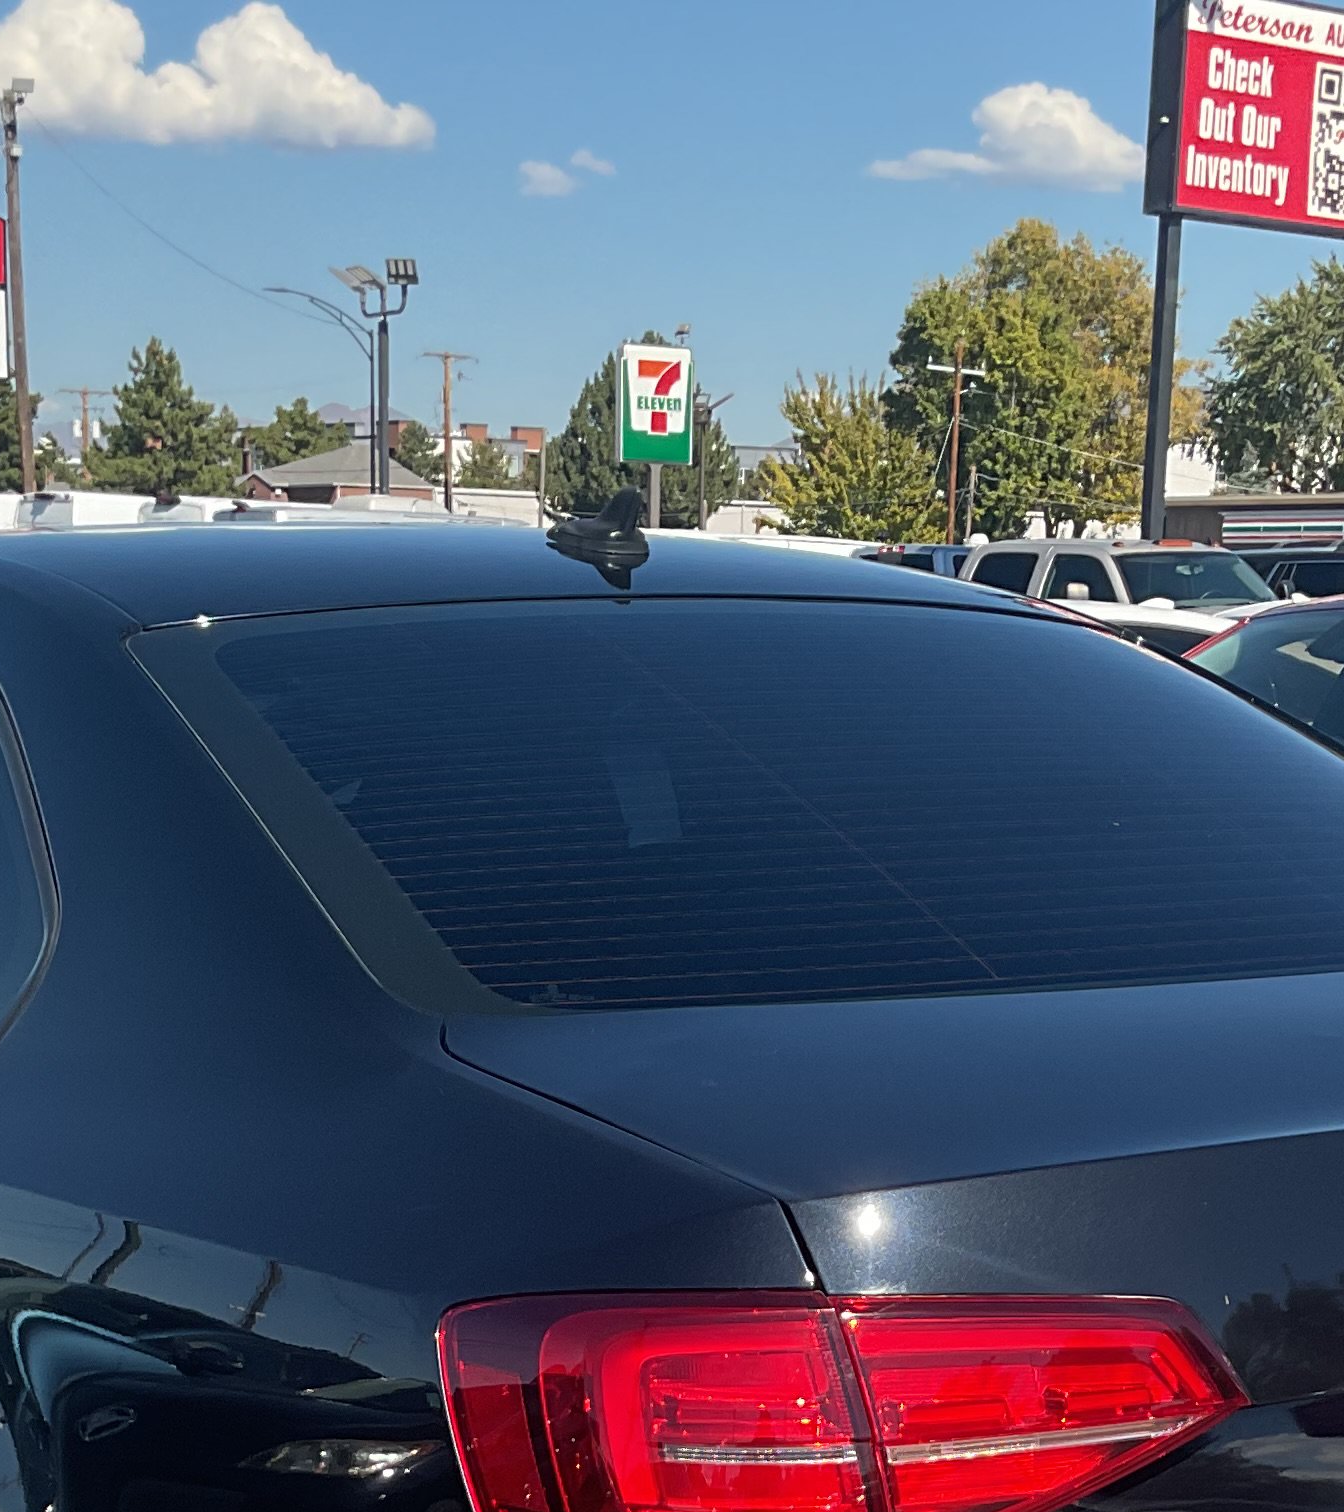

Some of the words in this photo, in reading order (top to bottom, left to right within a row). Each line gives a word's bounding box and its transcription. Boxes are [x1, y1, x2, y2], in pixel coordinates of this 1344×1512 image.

[1198, 0, 1313, 43] Peterson
[1208, 47, 1274, 98] Check
[1199, 97, 1235, 143] Out
[1241, 104, 1281, 149] Our
[1186, 144, 1289, 206] Inventory
[638, 359, 681, 433] 7
